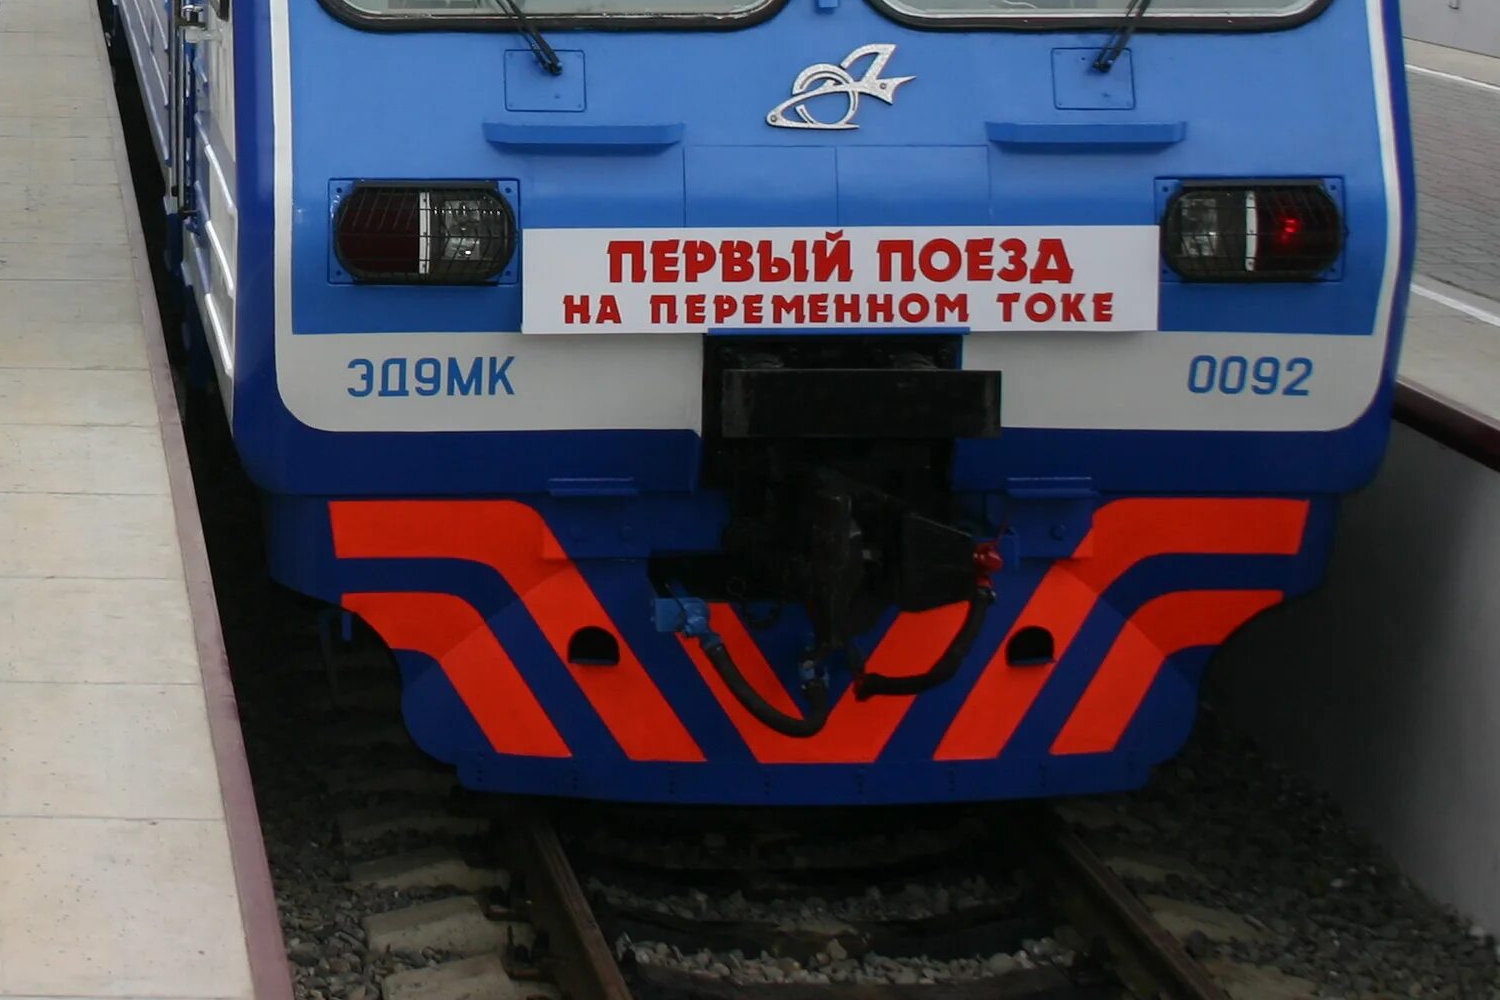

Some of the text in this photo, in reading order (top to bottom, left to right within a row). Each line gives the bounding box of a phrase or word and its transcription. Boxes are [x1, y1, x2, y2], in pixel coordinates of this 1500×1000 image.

[608, 228, 1074, 285] ПЕРВЫЙ ПОЕЗД
[563, 291, 1114, 325] НА ПЕРЕМЕННОМ ТОКЕ
[348, 356, 516, 398] ЭД9МК
[1187, 354, 1314, 397] 0092
